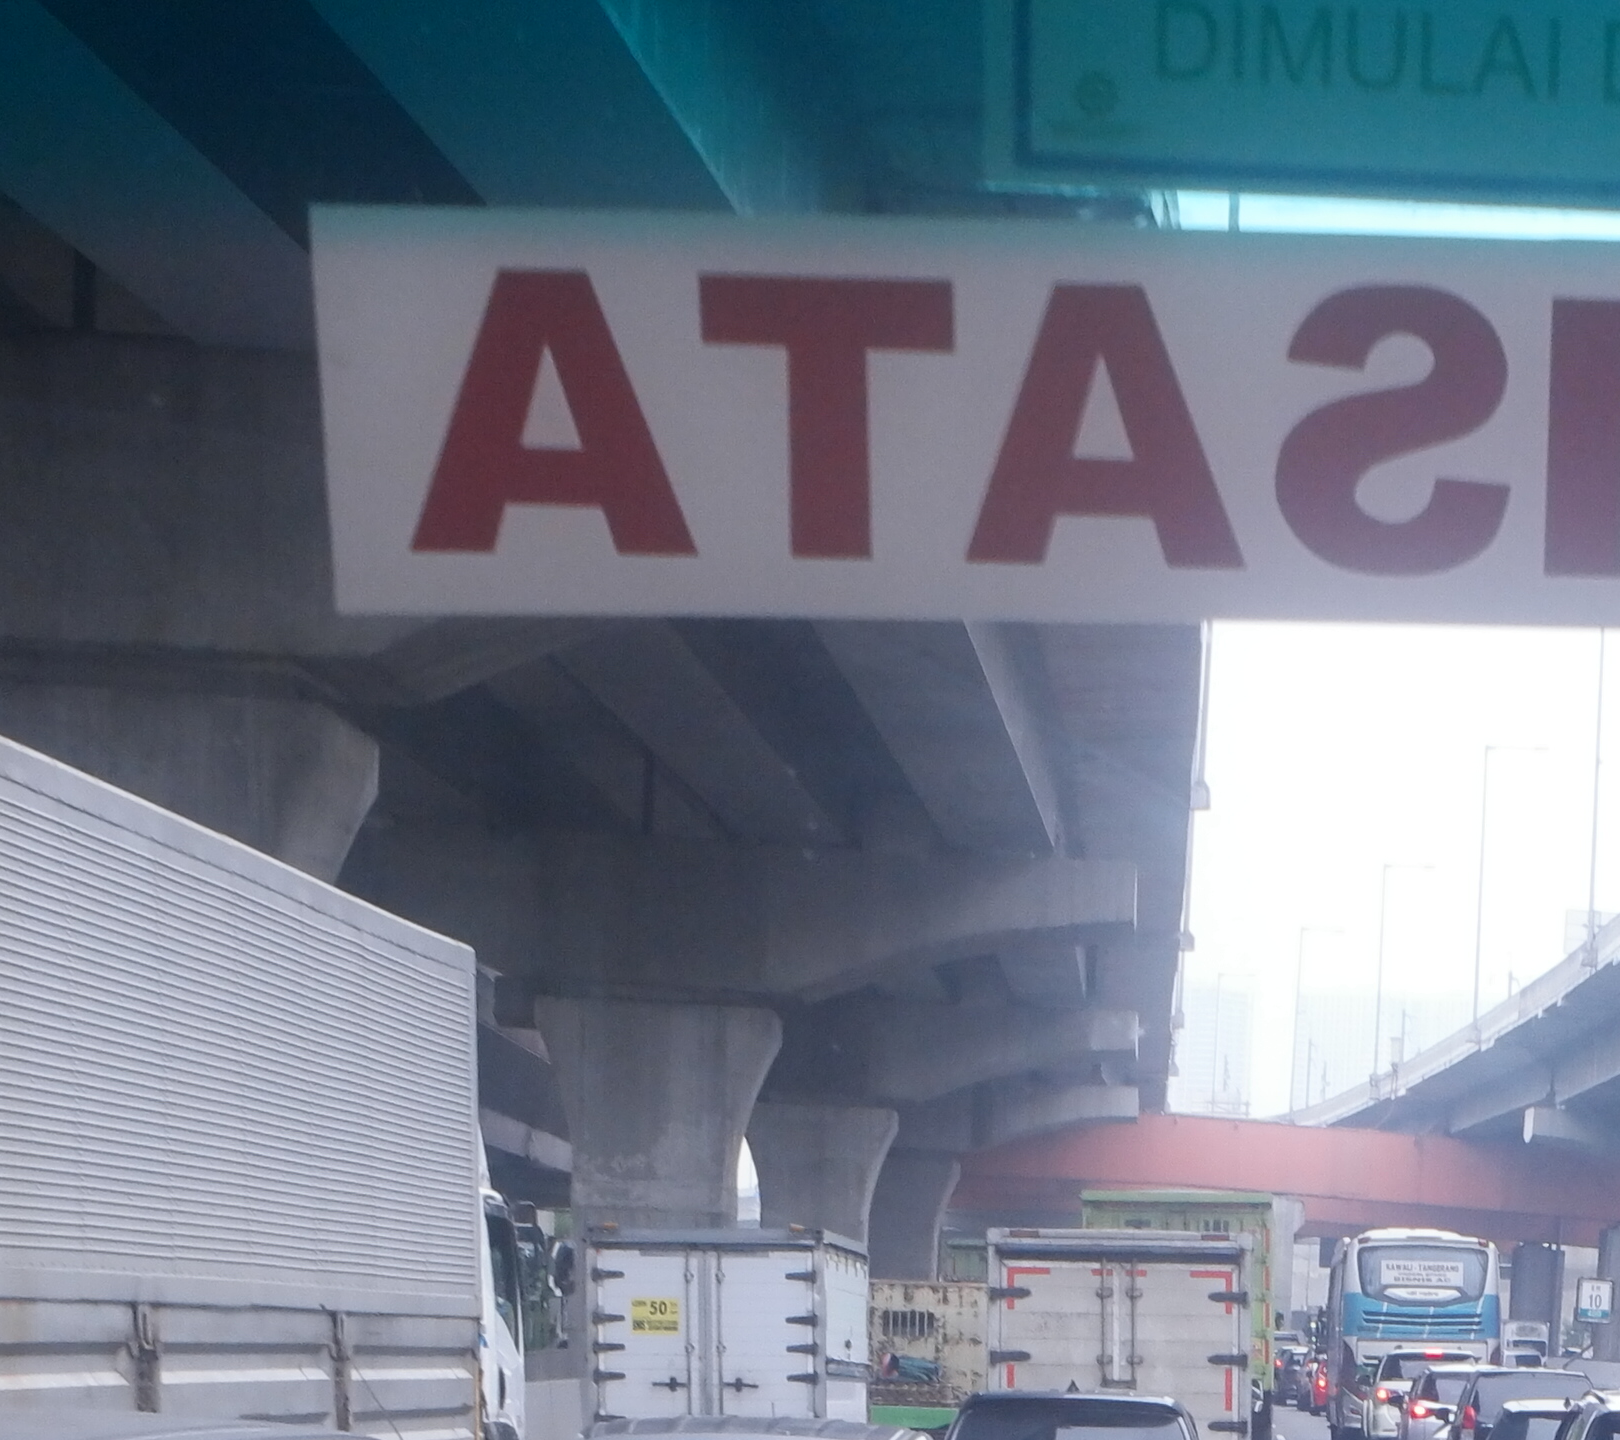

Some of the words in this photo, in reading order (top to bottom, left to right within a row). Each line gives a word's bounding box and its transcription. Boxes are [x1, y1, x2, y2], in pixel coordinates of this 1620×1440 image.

[1152, 2, 1563, 98] DIMULAI
[649, 1301, 668, 1315] 50
[1589, 1294, 1602, 1308] 10
